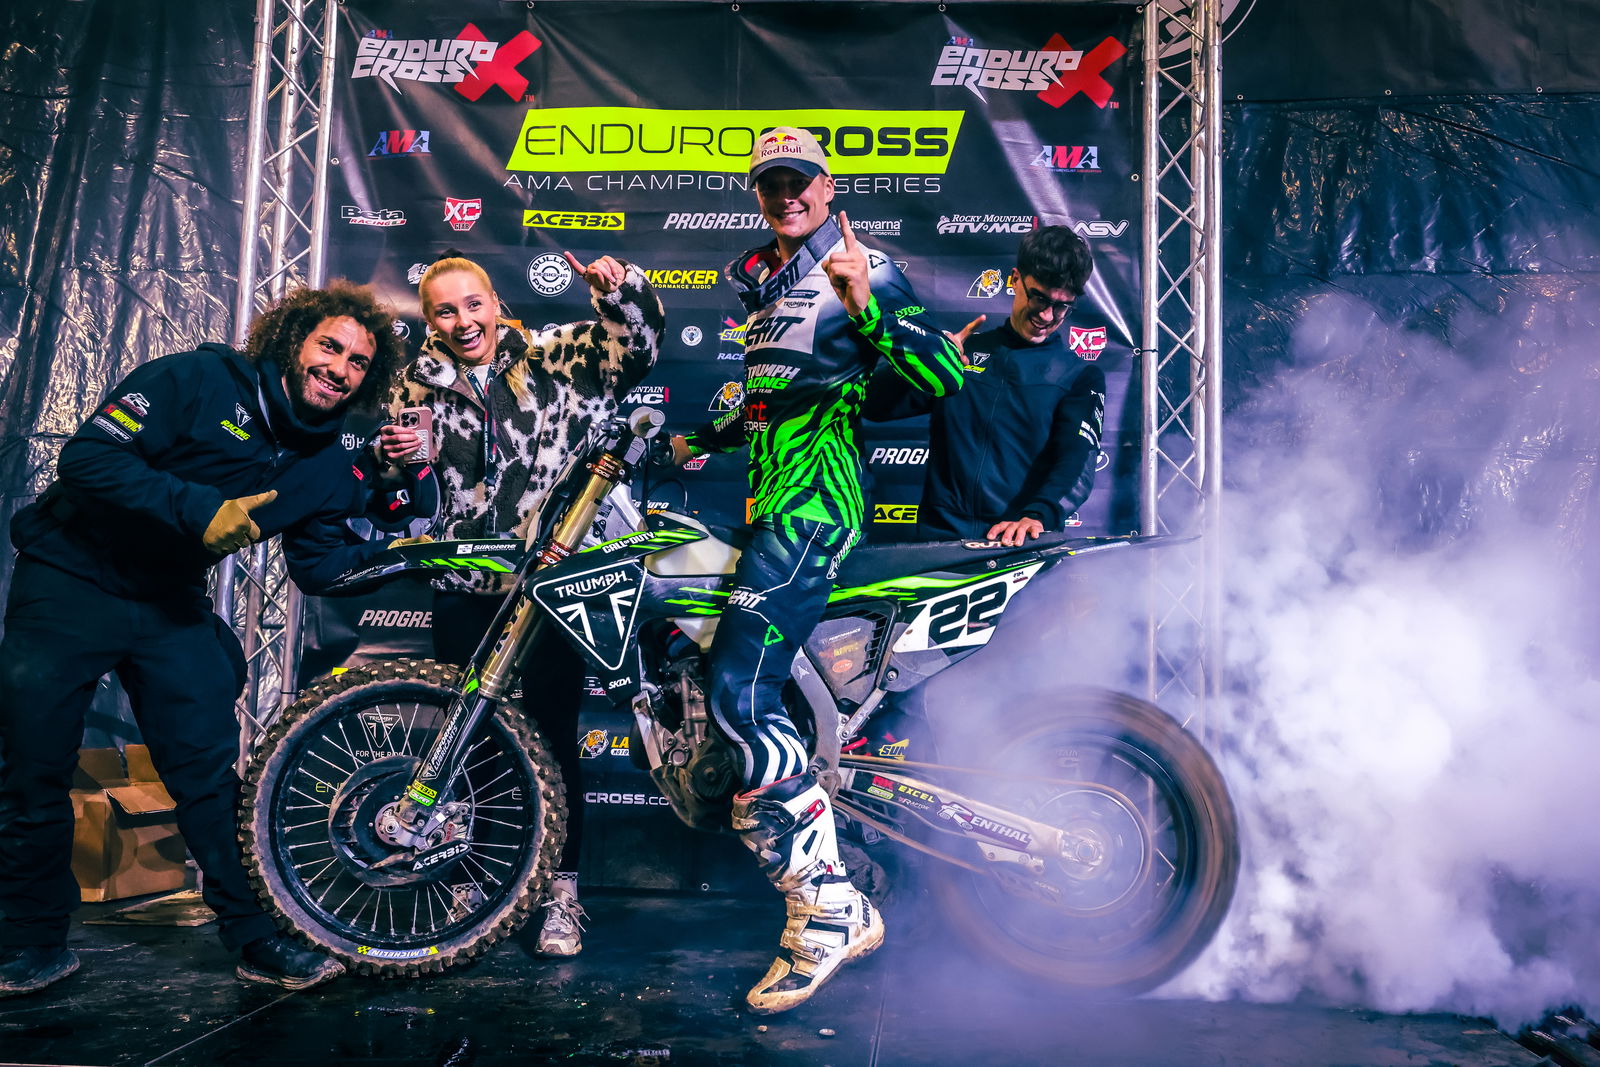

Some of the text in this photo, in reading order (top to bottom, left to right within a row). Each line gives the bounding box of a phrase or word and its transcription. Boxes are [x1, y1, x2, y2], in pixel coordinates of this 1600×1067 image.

[359, 38, 499, 80] ENDURO
[937, 46, 1084, 88] ENDURO
[351, 58, 466, 95] CROSS
[931, 66, 1050, 104] CROSS
[368, 130, 431, 157] AMA
[525, 123, 949, 157] ENDUROROSS
[761, 145, 802, 158] Red Bull
[1030, 145, 1101, 169] AMA
[503, 173, 941, 193] AMA CHAMPION SERIES
[341, 205, 405, 220] Beta
[443, 202, 481, 222] XC
[525, 213, 623, 227] ACERBIS
[663, 213, 774, 230] PROGRESSIV
[952, 214, 1033, 223] ROCKY MOUNTAIN
[454, 223, 470, 231] GEAR
[838, 219, 900, 231] usqvarna
[1074, 221, 1128, 237] ASV
[532, 256, 571, 272] BULLET
[532, 278, 568, 293] PROOF
[651, 269, 718, 285] KICKER
[1069, 331, 1107, 351] XC
[602, 541, 628, 554] CALL
[628, 532, 655, 545] DUTY
[555, 570, 632, 598] TRIUMPH
[358, 609, 433, 628] PROGRE
[928, 581, 1008, 649] 22
[431, 703, 463, 766] PERFORMANCE
[355, 750, 370, 758] FOR
[585, 793, 671, 805] CROSS.CO
[898, 785, 935, 803] EXCEL
[937, 802, 1032, 844] RENTHAL
[413, 844, 469, 872] ACERBIS
[371, 949, 420, 958] MICHELIN
